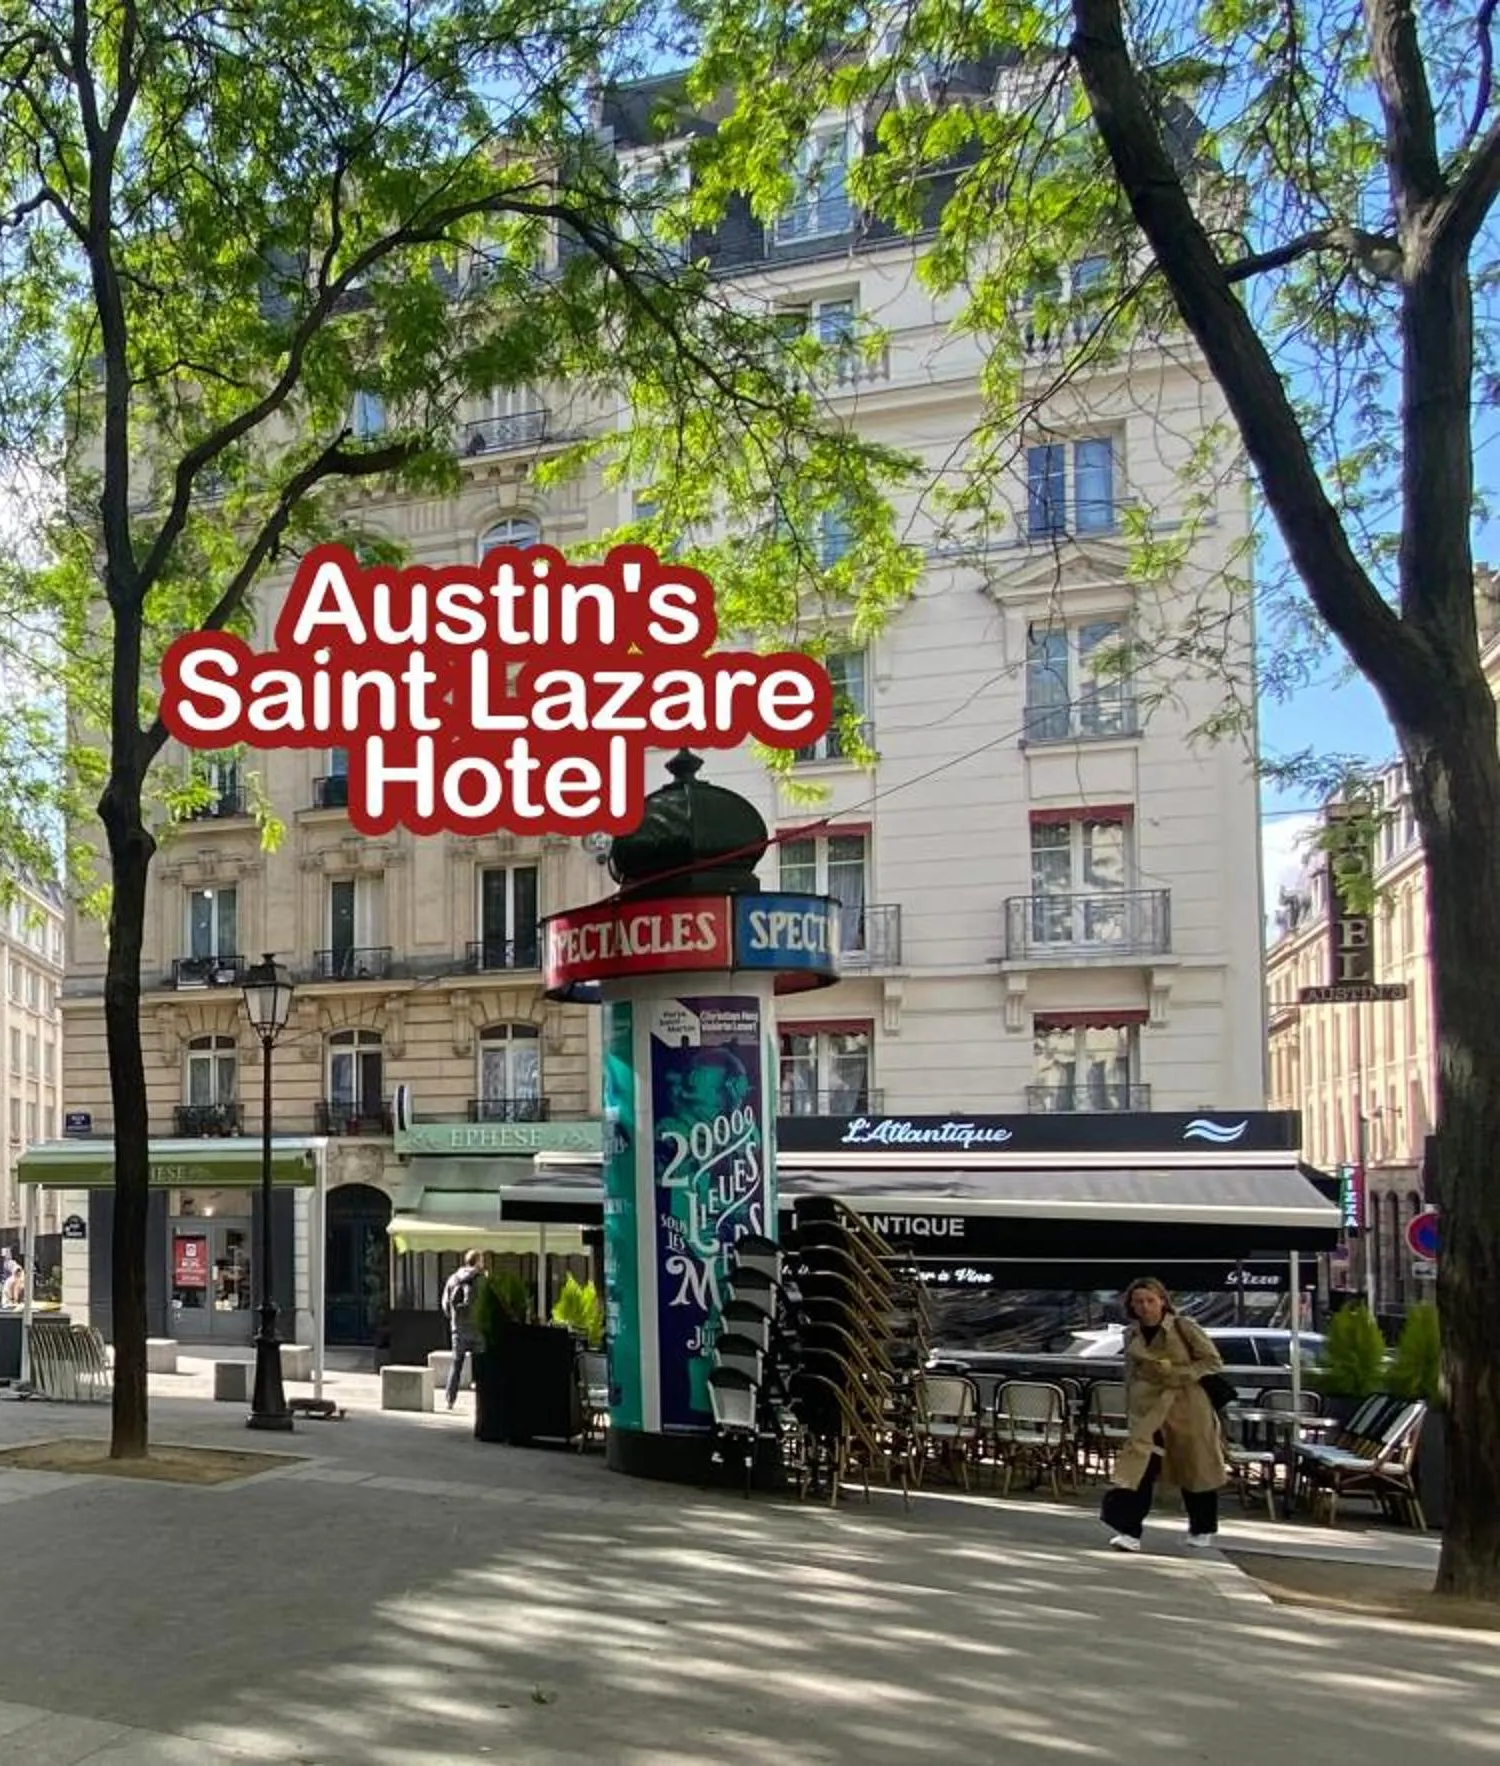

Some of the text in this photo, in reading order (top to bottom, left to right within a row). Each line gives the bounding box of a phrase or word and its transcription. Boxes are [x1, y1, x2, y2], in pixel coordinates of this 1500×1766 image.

[749, 910, 832, 954] SPECT
[1307, 985, 1404, 1001] AUSTIN'S
[841, 1117, 1012, 1148] L'Atlantique
[1343, 1167, 1361, 1228] PIZZA
